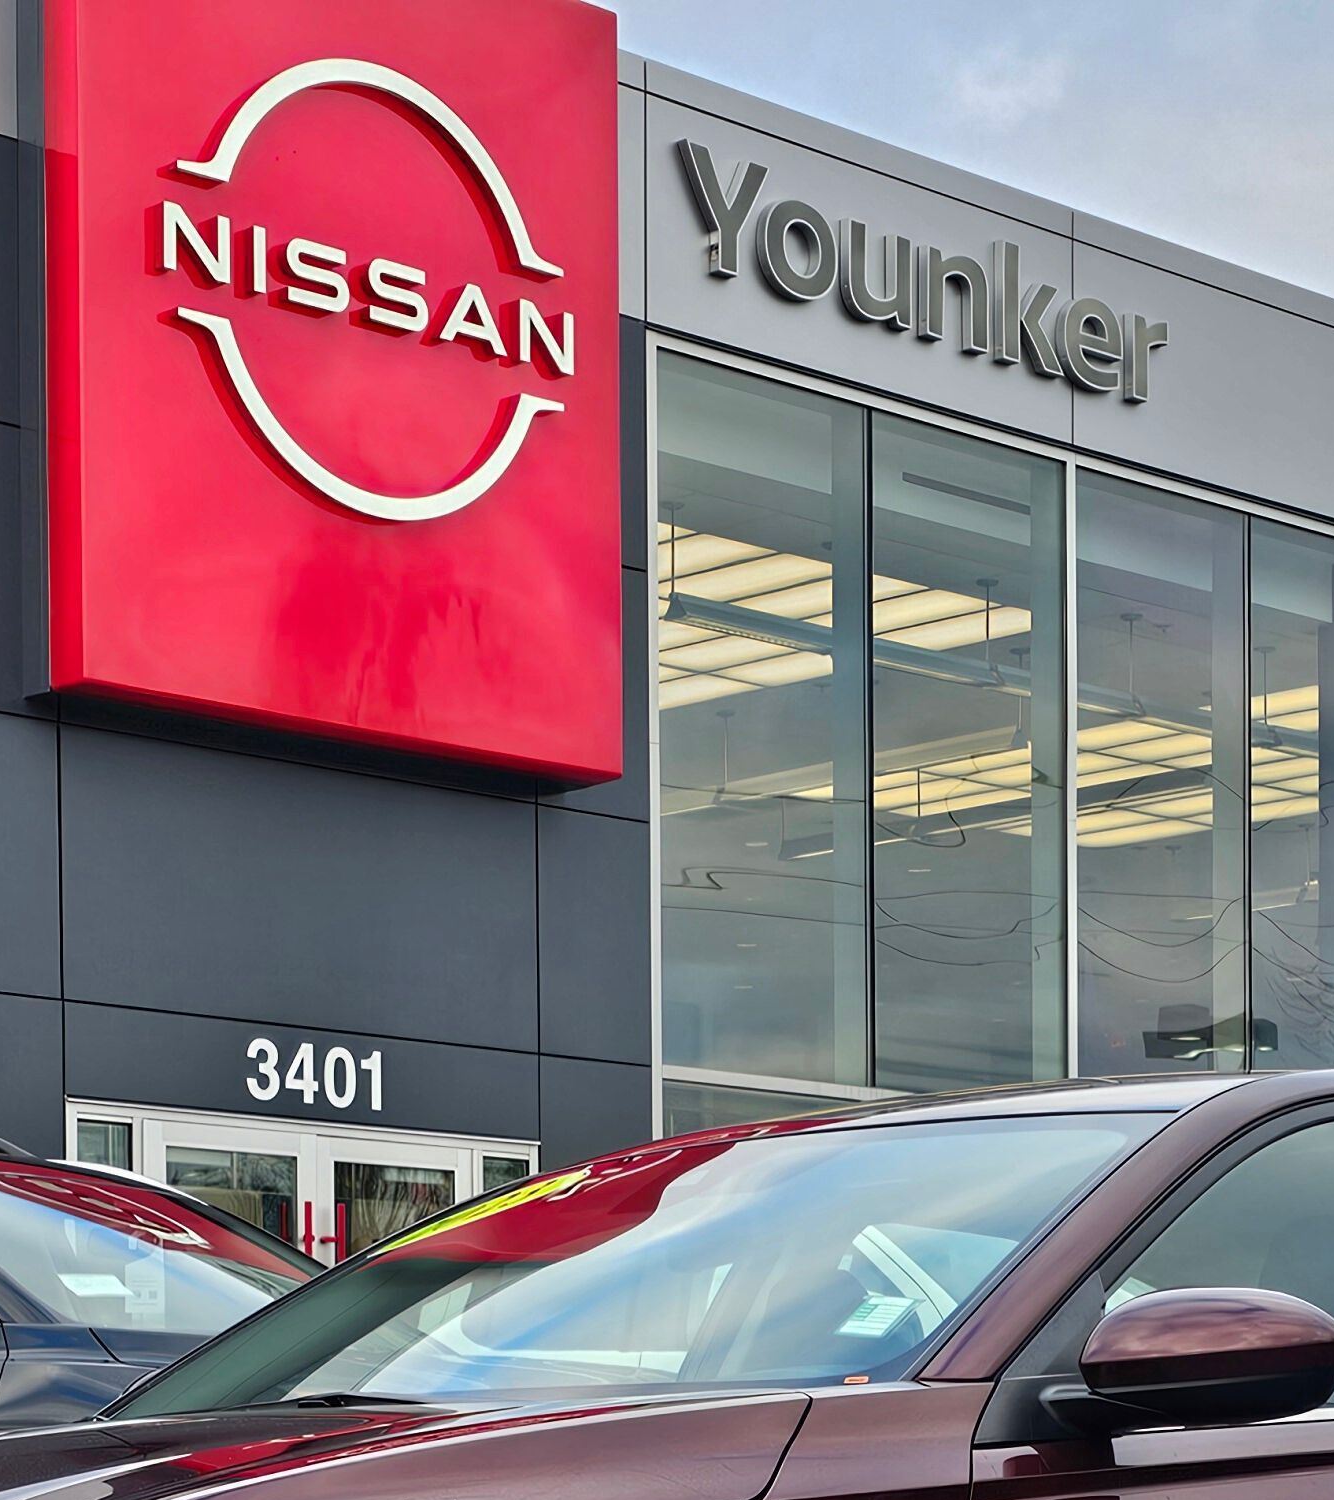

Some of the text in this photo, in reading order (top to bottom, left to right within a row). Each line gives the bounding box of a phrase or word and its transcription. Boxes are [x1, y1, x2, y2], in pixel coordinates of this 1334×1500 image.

[161, 200, 575, 377] NISSAN
[676, 138, 1168, 403] Younker
[246, 1037, 382, 1111] 3401
